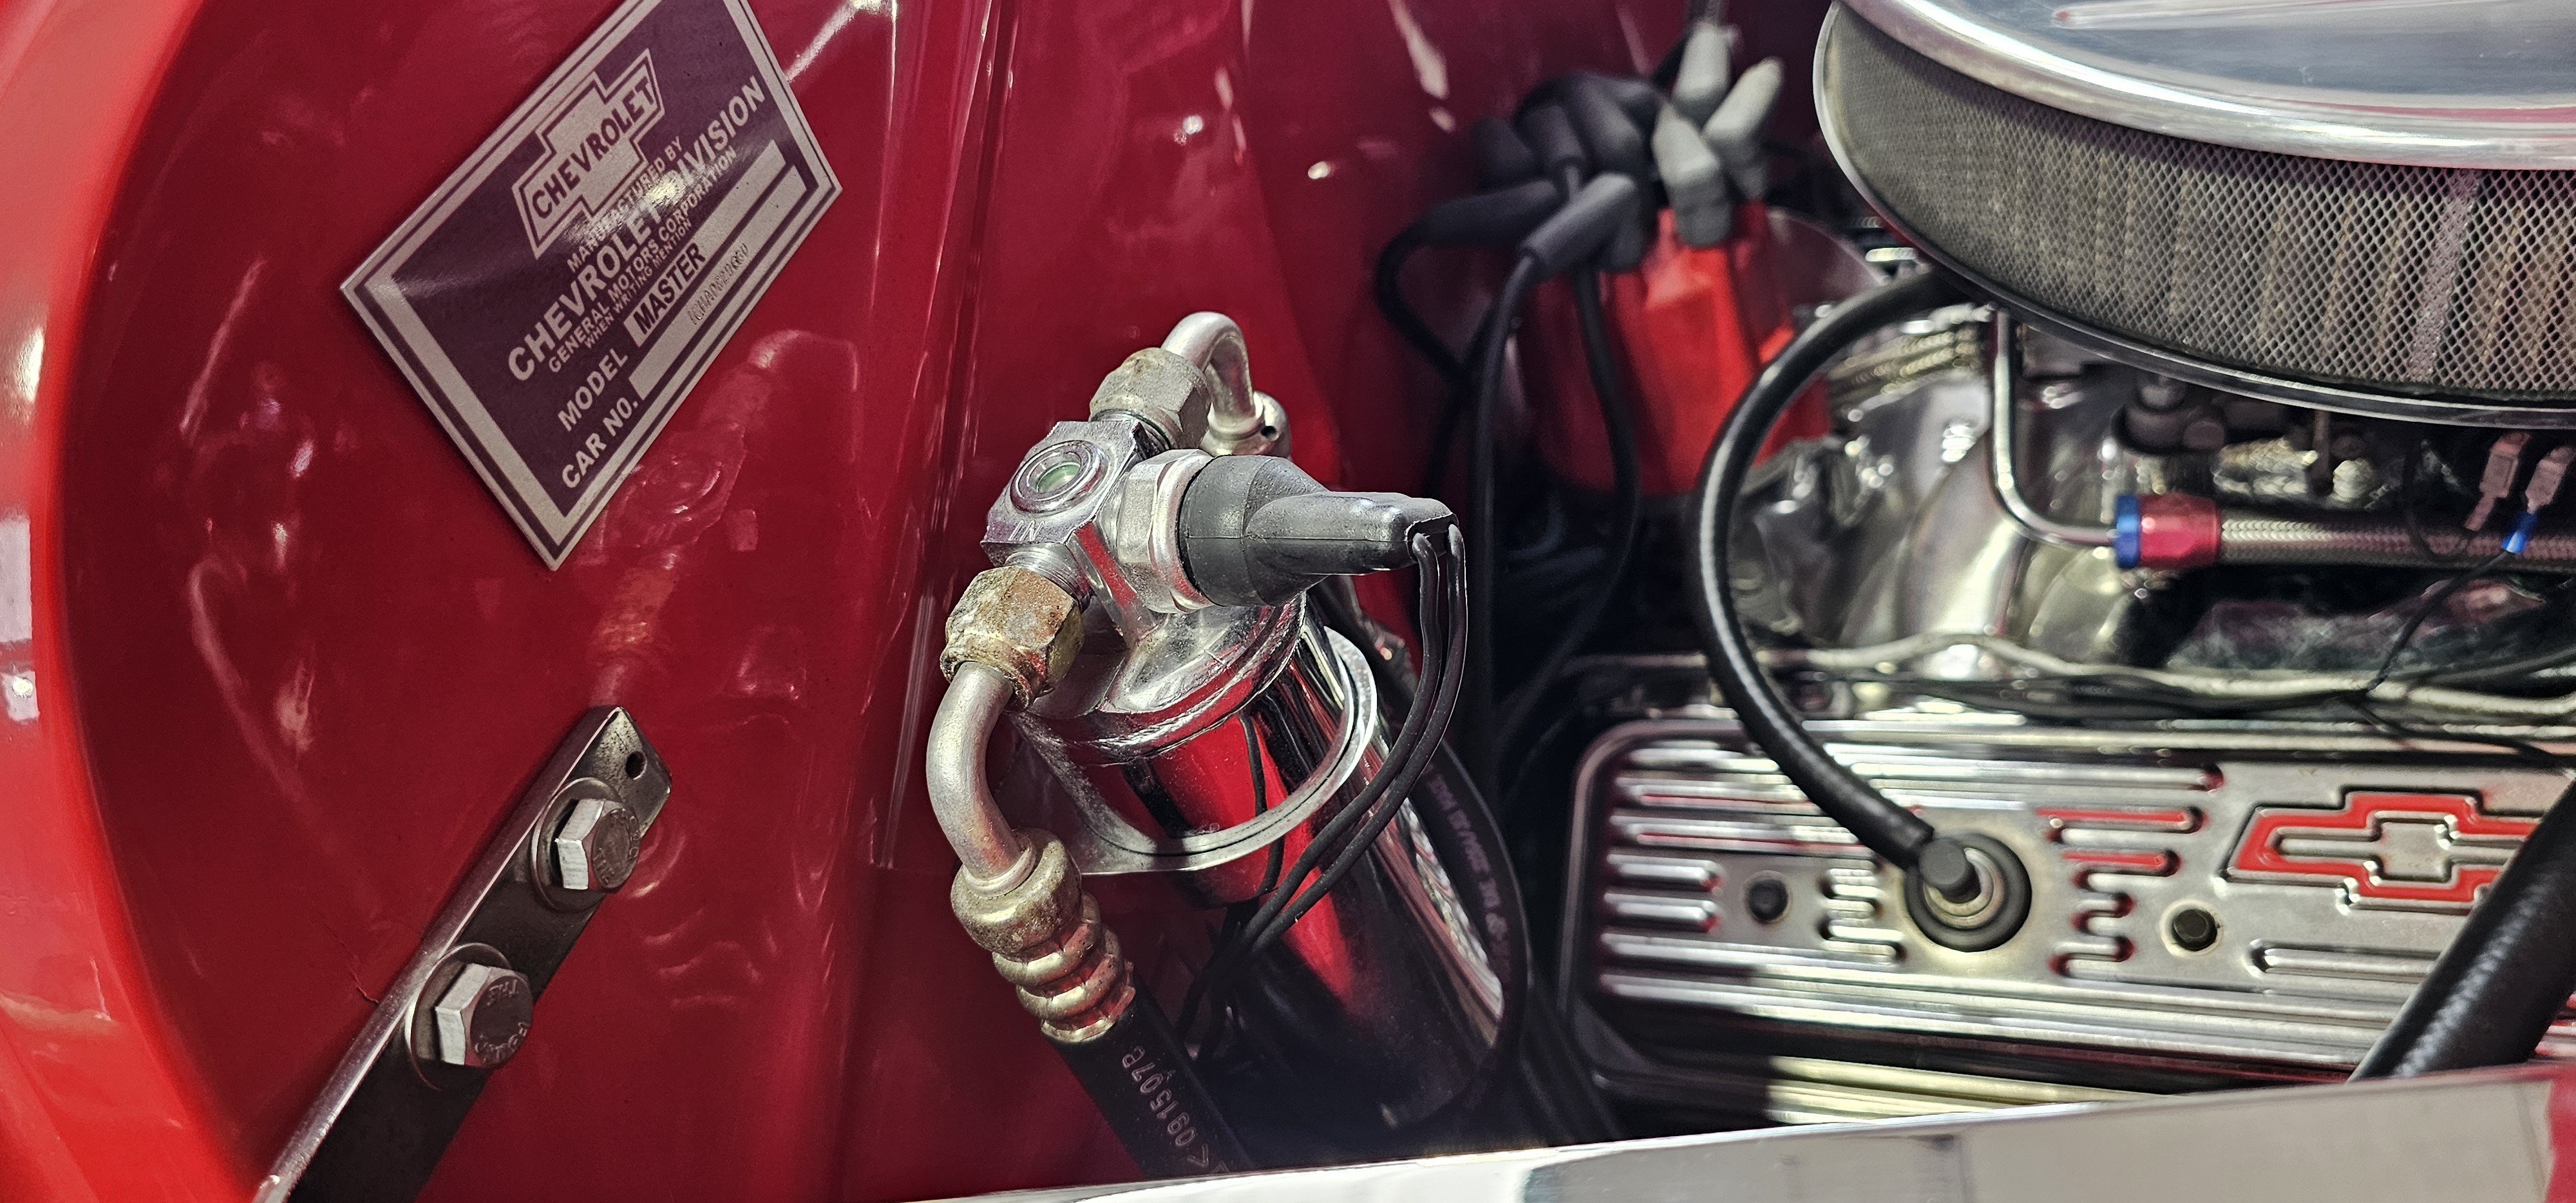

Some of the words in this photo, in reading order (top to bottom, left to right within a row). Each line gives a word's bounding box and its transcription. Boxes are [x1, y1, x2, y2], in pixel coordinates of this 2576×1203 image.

[532, 75, 655, 219] CHEVROLET
[665, 136, 683, 162] BY
[508, 195, 661, 381] CHEVROLET
[660, 75, 766, 205] DIVISION
[549, 302, 610, 373] GENERAL
[608, 239, 659, 302] MOTORS
[658, 145, 737, 242] CORPORATION
[585, 313, 615, 348] WHEN
[612, 267, 653, 314] WRITING
[652, 220, 692, 269] MENTION
[558, 348, 629, 432] MODEL
[633, 242, 706, 336] MASTER
[562, 432, 607, 488] CAR
[603, 397, 639, 437] NO.
[1008, 520, 1046, 542] IN
